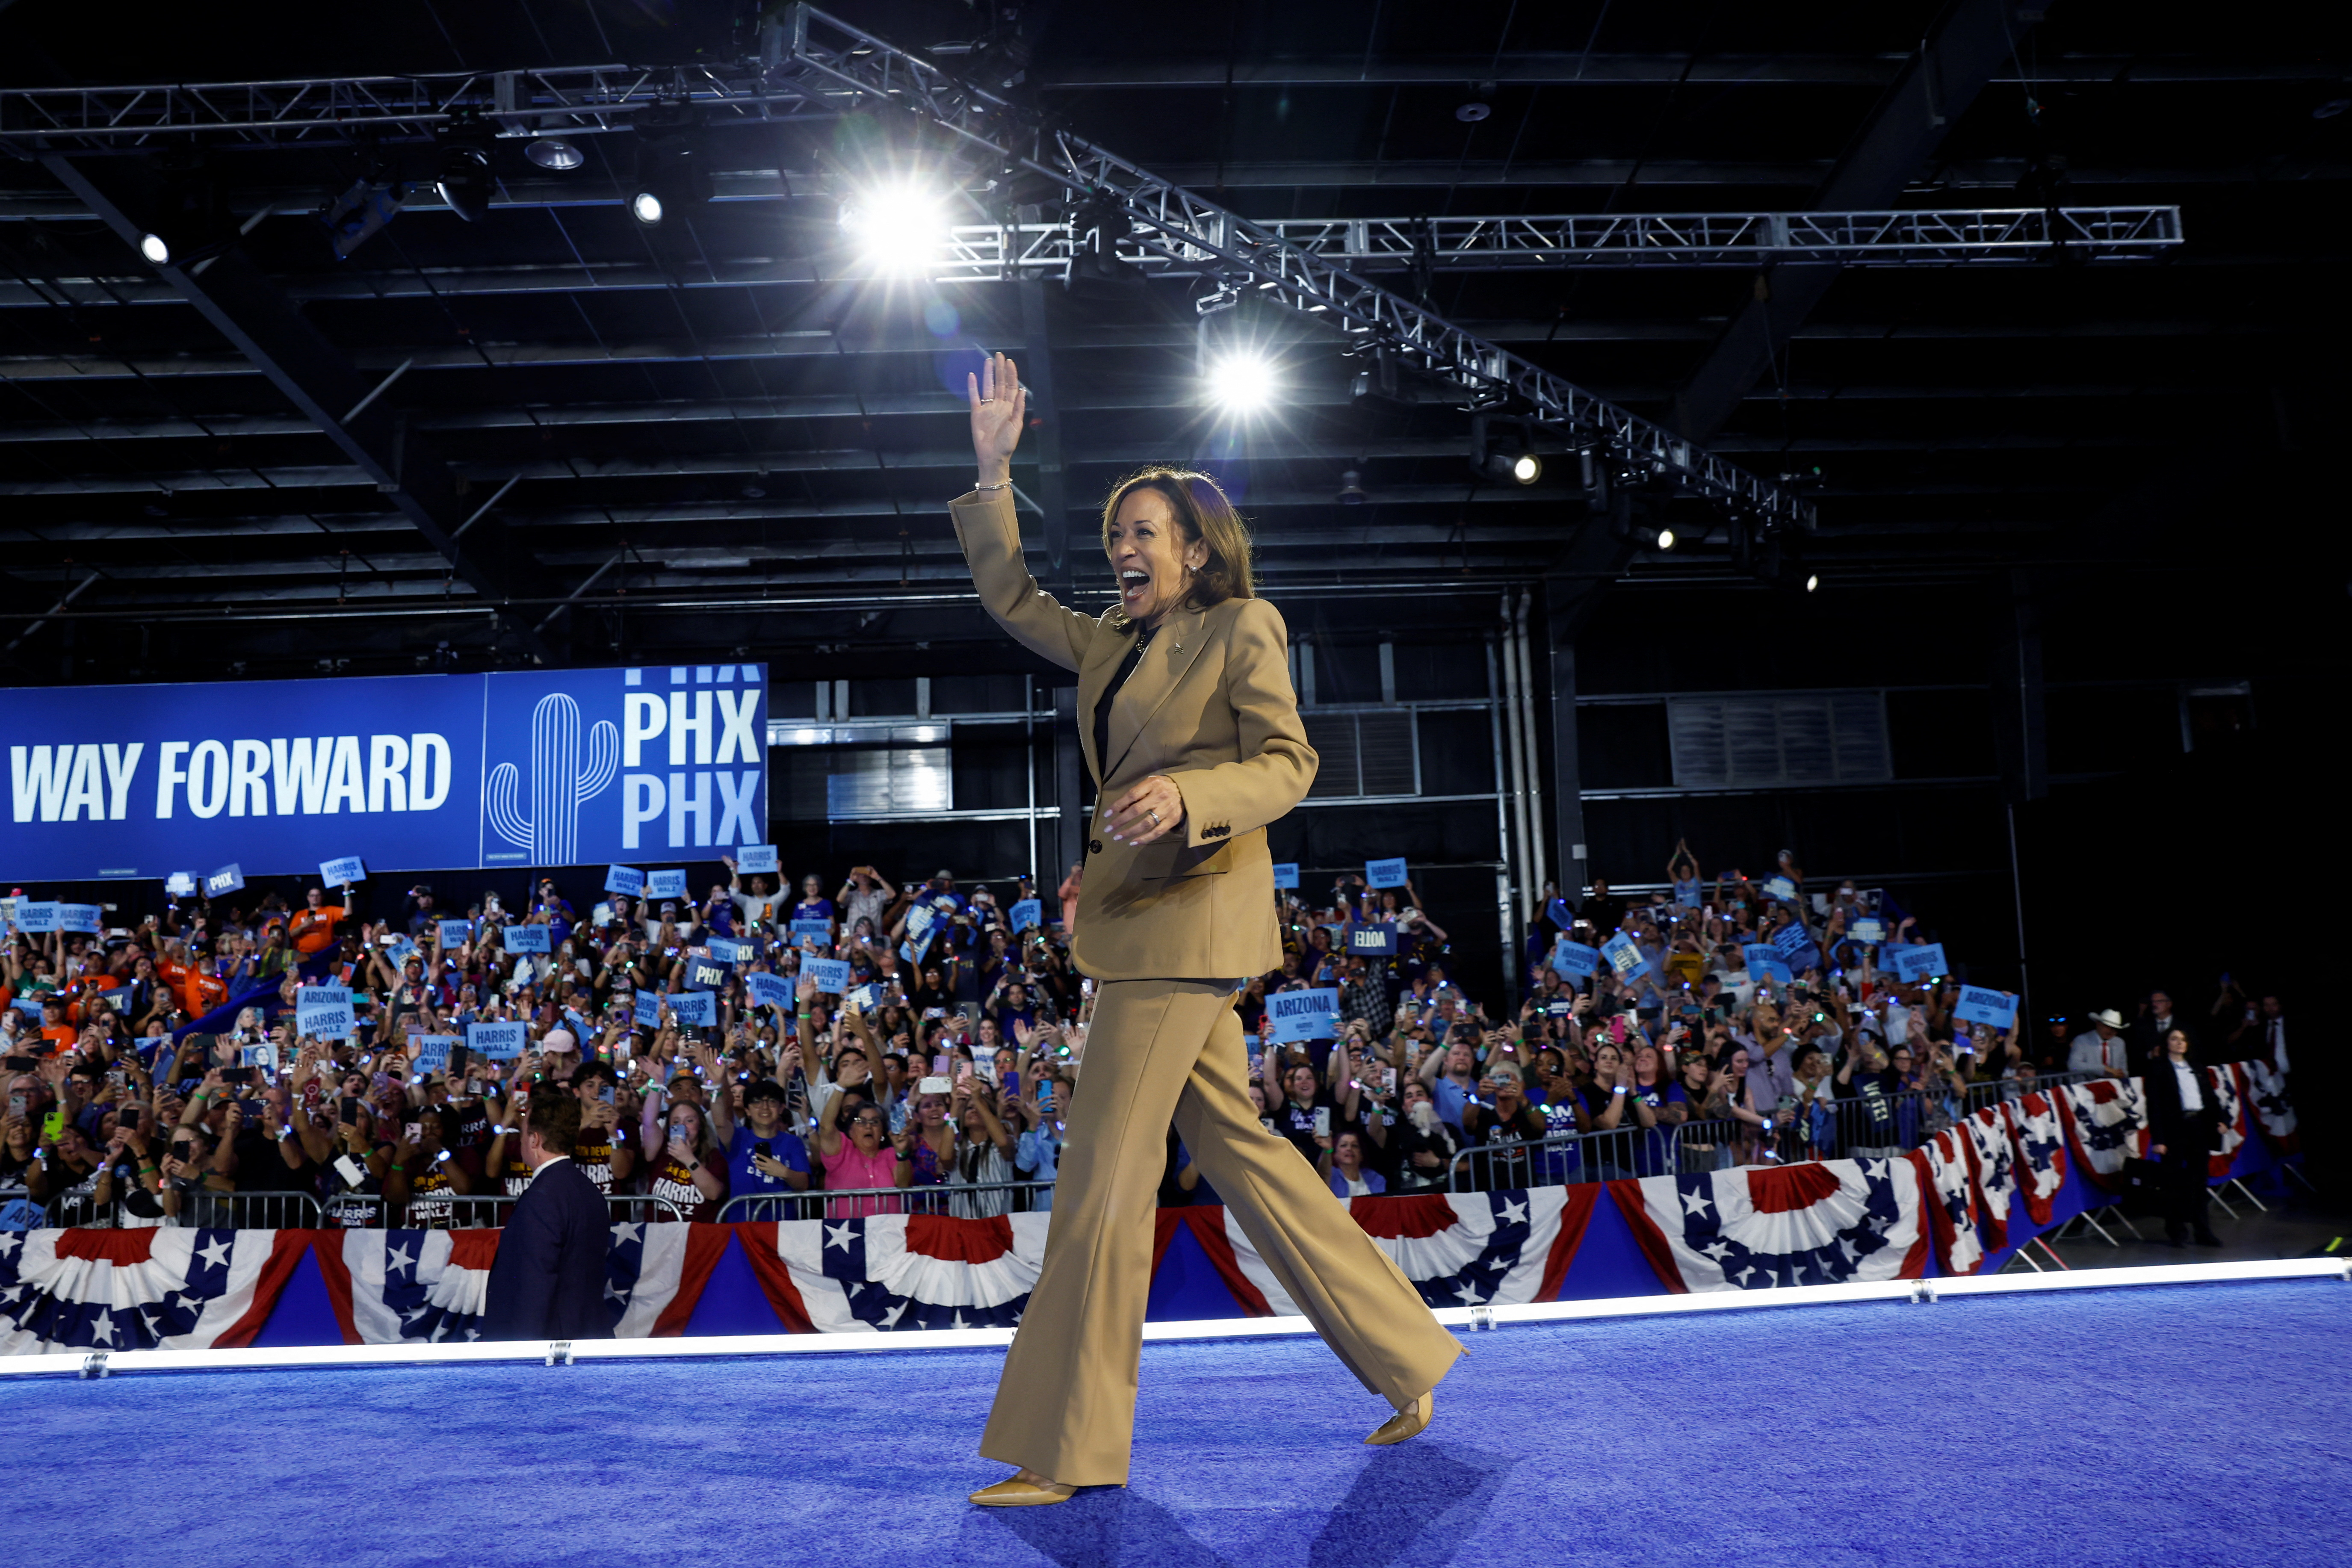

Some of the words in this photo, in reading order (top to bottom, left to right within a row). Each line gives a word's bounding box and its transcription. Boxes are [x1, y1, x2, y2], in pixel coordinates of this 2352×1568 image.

[623, 689, 761, 767] PHX
[10, 742, 145, 823] WAY
[156, 732, 452, 819] FORWARD
[623, 771, 761, 849] PHX
[743, 850, 771, 862] HARRIS
[327, 861, 357, 876] HARRIS
[1371, 864, 1401, 876] HARRIS
[209, 871, 234, 891] PHX
[613, 871, 641, 885] HARRIS
[653, 875, 680, 886] HARRIS
[616, 882, 636, 890] WALZ
[21, 907, 53, 919] HARRIS
[511, 929, 544, 941] HARRIS
[737, 945, 754, 961] HX
[695, 965, 724, 986] PHX
[820, 977, 836, 986] ALZ
[756, 977, 787, 997] HARRIS
[304, 991, 346, 1004] ARIZONA
[1276, 995, 1331, 1018] ARIZONA
[305, 1010, 346, 1029] HARRIS
[476, 1029, 517, 1044] HARRIS
[422, 1042, 449, 1057] ARRI
[483, 1044, 511, 1052] WALZ
[652, 1177, 705, 1205] HARRIS
